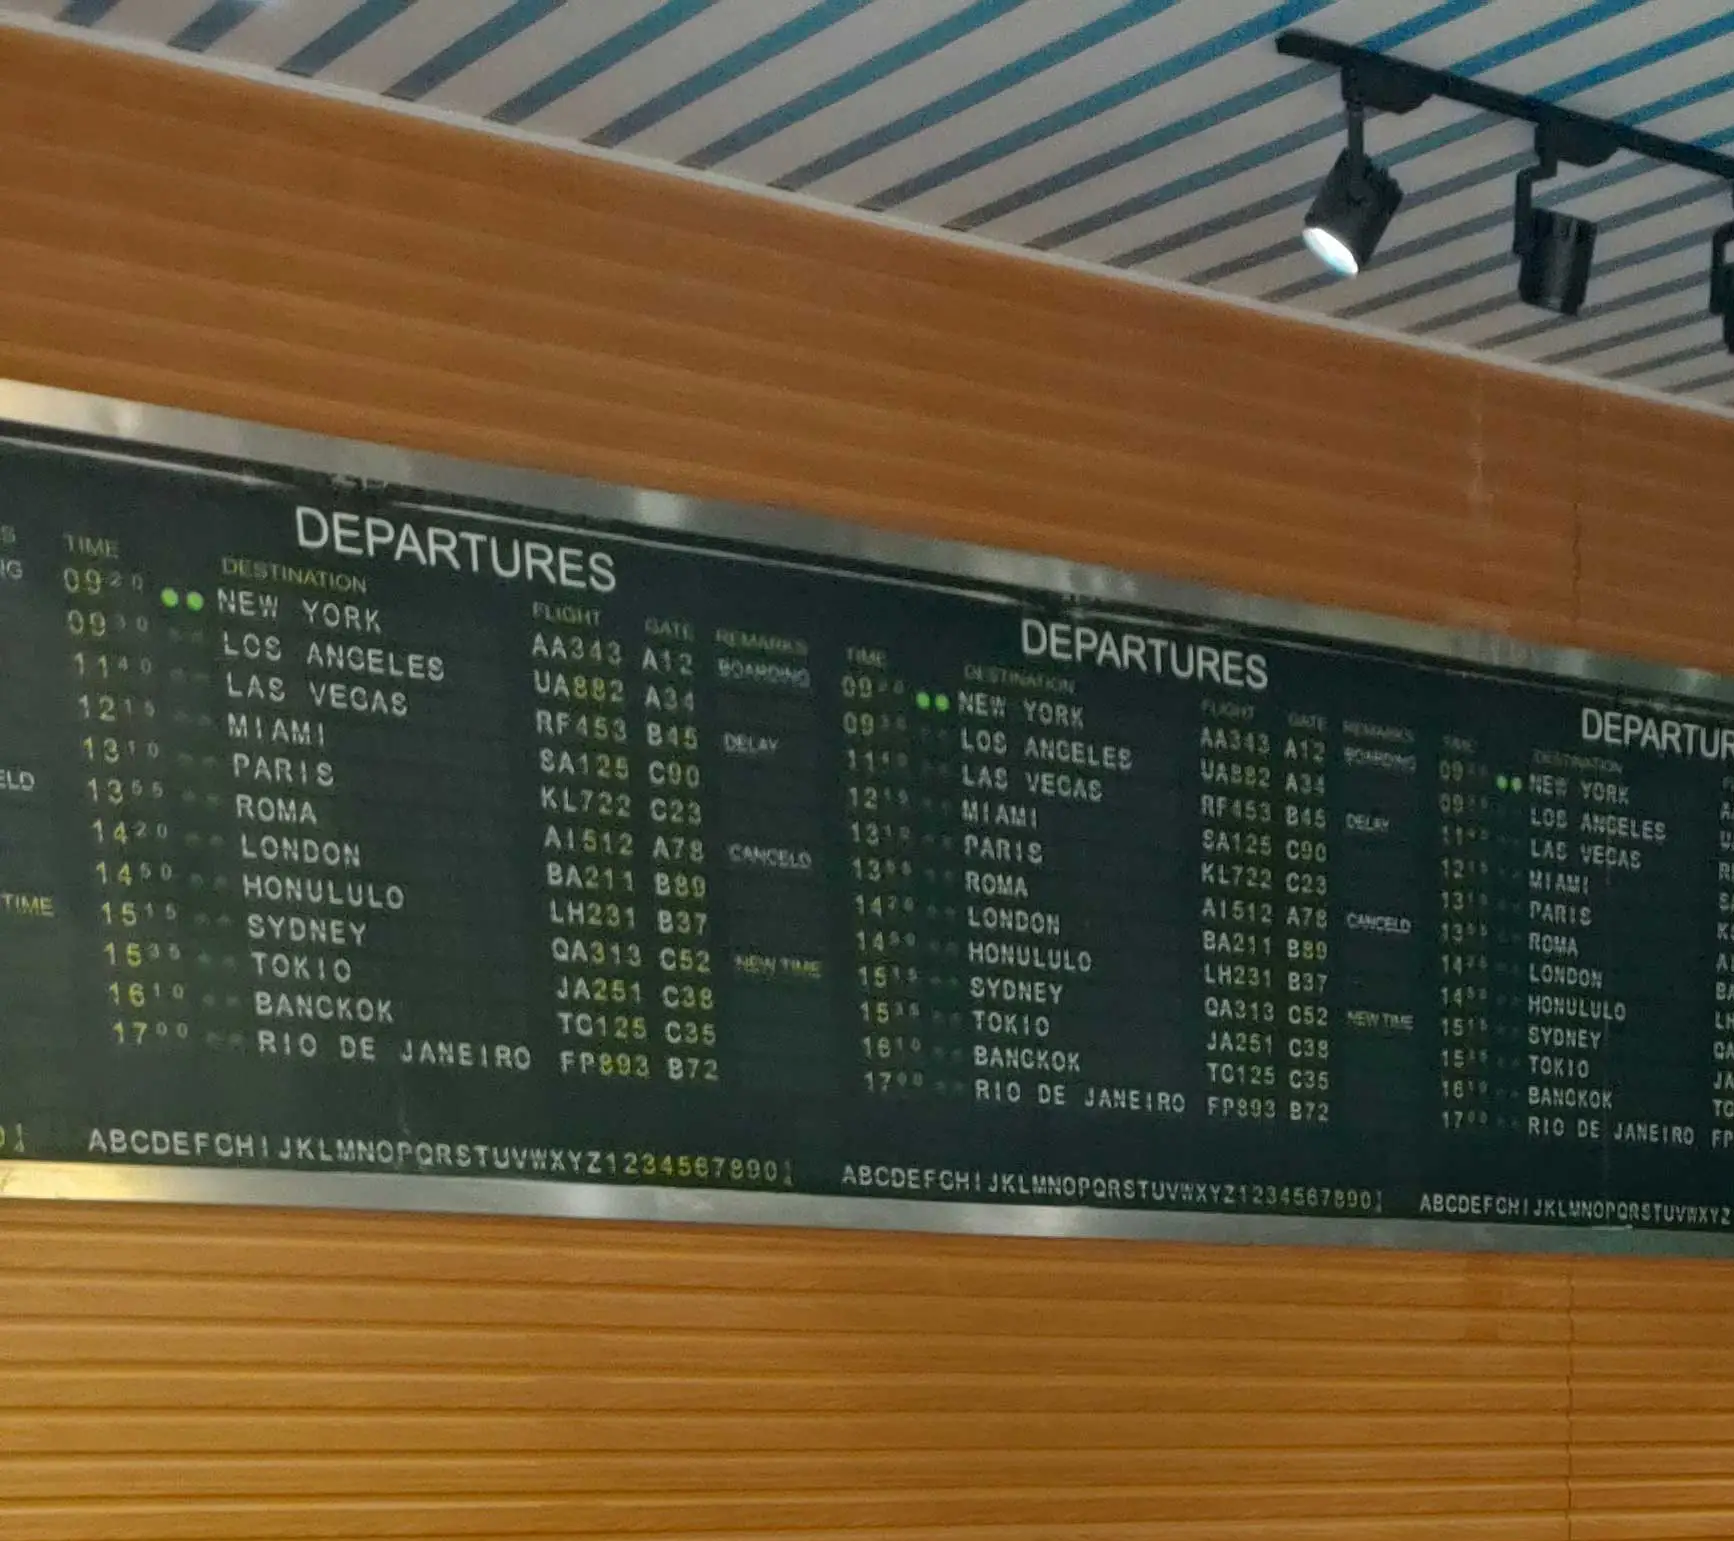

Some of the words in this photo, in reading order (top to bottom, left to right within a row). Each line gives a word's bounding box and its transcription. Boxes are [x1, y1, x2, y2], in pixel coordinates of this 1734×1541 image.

[296, 505, 616, 593] DEPARTURES
[64, 534, 118, 558] TIME
[221, 556, 367, 594] DESTINATION
[533, 602, 600, 625] FLIGHT
[217, 588, 277, 617] NEW
[302, 600, 380, 633] YORK
[532, 633, 621, 665] AA343
[643, 648, 692, 675] A12
[1021, 618, 1268, 690] DEPARTURES
[223, 632, 281, 661] LOS
[645, 686, 693, 711] A34
[227, 672, 285, 702] LAS
[536, 710, 626, 741] RF453
[647, 723, 697, 749] B45
[724, 733, 778, 752] DELAY
[959, 691, 1005, 716] NEW
[1023, 699, 1083, 728] YORK
[1201, 727, 1270, 754] AA343
[1284, 738, 1324, 762] A12
[228, 713, 324, 746] MIAMI
[540, 748, 628, 779] SA125
[961, 728, 1006, 754] LOS
[1286, 773, 1324, 794] A34
[233, 753, 333, 786] PARIS
[541, 786, 630, 817] KL722
[650, 798, 701, 825] C23
[962, 764, 1007, 790] LAS
[1286, 805, 1325, 828] B45
[1530, 774, 1566, 795] NEW
[1581, 781, 1629, 805] YORK
[236, 794, 317, 824] ROMA
[545, 825, 632, 855] AI512
[653, 836, 703, 862] A78
[962, 799, 1036, 828] MIAMI
[1203, 829, 1271, 855] SA125
[1286, 839, 1326, 862] C90
[1531, 839, 1567, 860] LAS
[241, 834, 360, 867] LONDON
[547, 862, 632, 891] BA211
[965, 834, 1042, 864] PARIS
[1202, 862, 1271, 889] KL722
[1286, 872, 1326, 895] C23
[1530, 870, 1588, 895] MIAMI
[243, 874, 404, 909] HONULULO
[550, 900, 634, 928] LH231
[658, 910, 707, 935] B37
[966, 871, 1028, 897] ROMA
[1202, 897, 1272, 923] AI512
[1287, 906, 1327, 928] A78
[1530, 901, 1591, 926] PARIS
[248, 914, 365, 946] SYDNEY
[552, 937, 641, 966] QA313
[660, 947, 710, 973] C52
[968, 906, 1059, 935] LONDON
[1203, 930, 1270, 955] BA211
[1529, 932, 1578, 957] ROMA
[251, 952, 351, 983] TOKIO
[557, 976, 640, 1002] JA251
[662, 985, 713, 1009] C38
[968, 941, 1091, 972] HONULULO
[1204, 963, 1270, 987] LH231
[1288, 972, 1327, 992] B37
[1529, 963, 1601, 988] LONDON
[971, 977, 1062, 1004] SYDNEY
[1205, 997, 1274, 1021] QA313
[1288, 1005, 1328, 1026] C52
[1528, 995, 1625, 1021] HONULULO
[258, 1031, 316, 1057] RIO
[340, 1035, 375, 1060] DE
[401, 1040, 530, 1070] JANEIRO
[668, 1057, 717, 1080] B72
[665, 1021, 715, 1045] C35
[972, 1010, 1049, 1037] TOKIO
[1207, 1031, 1271, 1053] JA251
[1529, 1026, 1601, 1049] SYDNEY
[1289, 1069, 1328, 1090] C35
[1529, 1055, 1589, 1078] TOKIO
[976, 1079, 1020, 1102] RIO
[1038, 1084, 1065, 1105] DE
[1085, 1088, 1185, 1112] JANEIRO
[1290, 1101, 1328, 1121] B72
[1529, 1116, 1564, 1136] RIO
[1578, 1119, 1599, 1138] DE
[1614, 1123, 1694, 1145] JANEIRO
